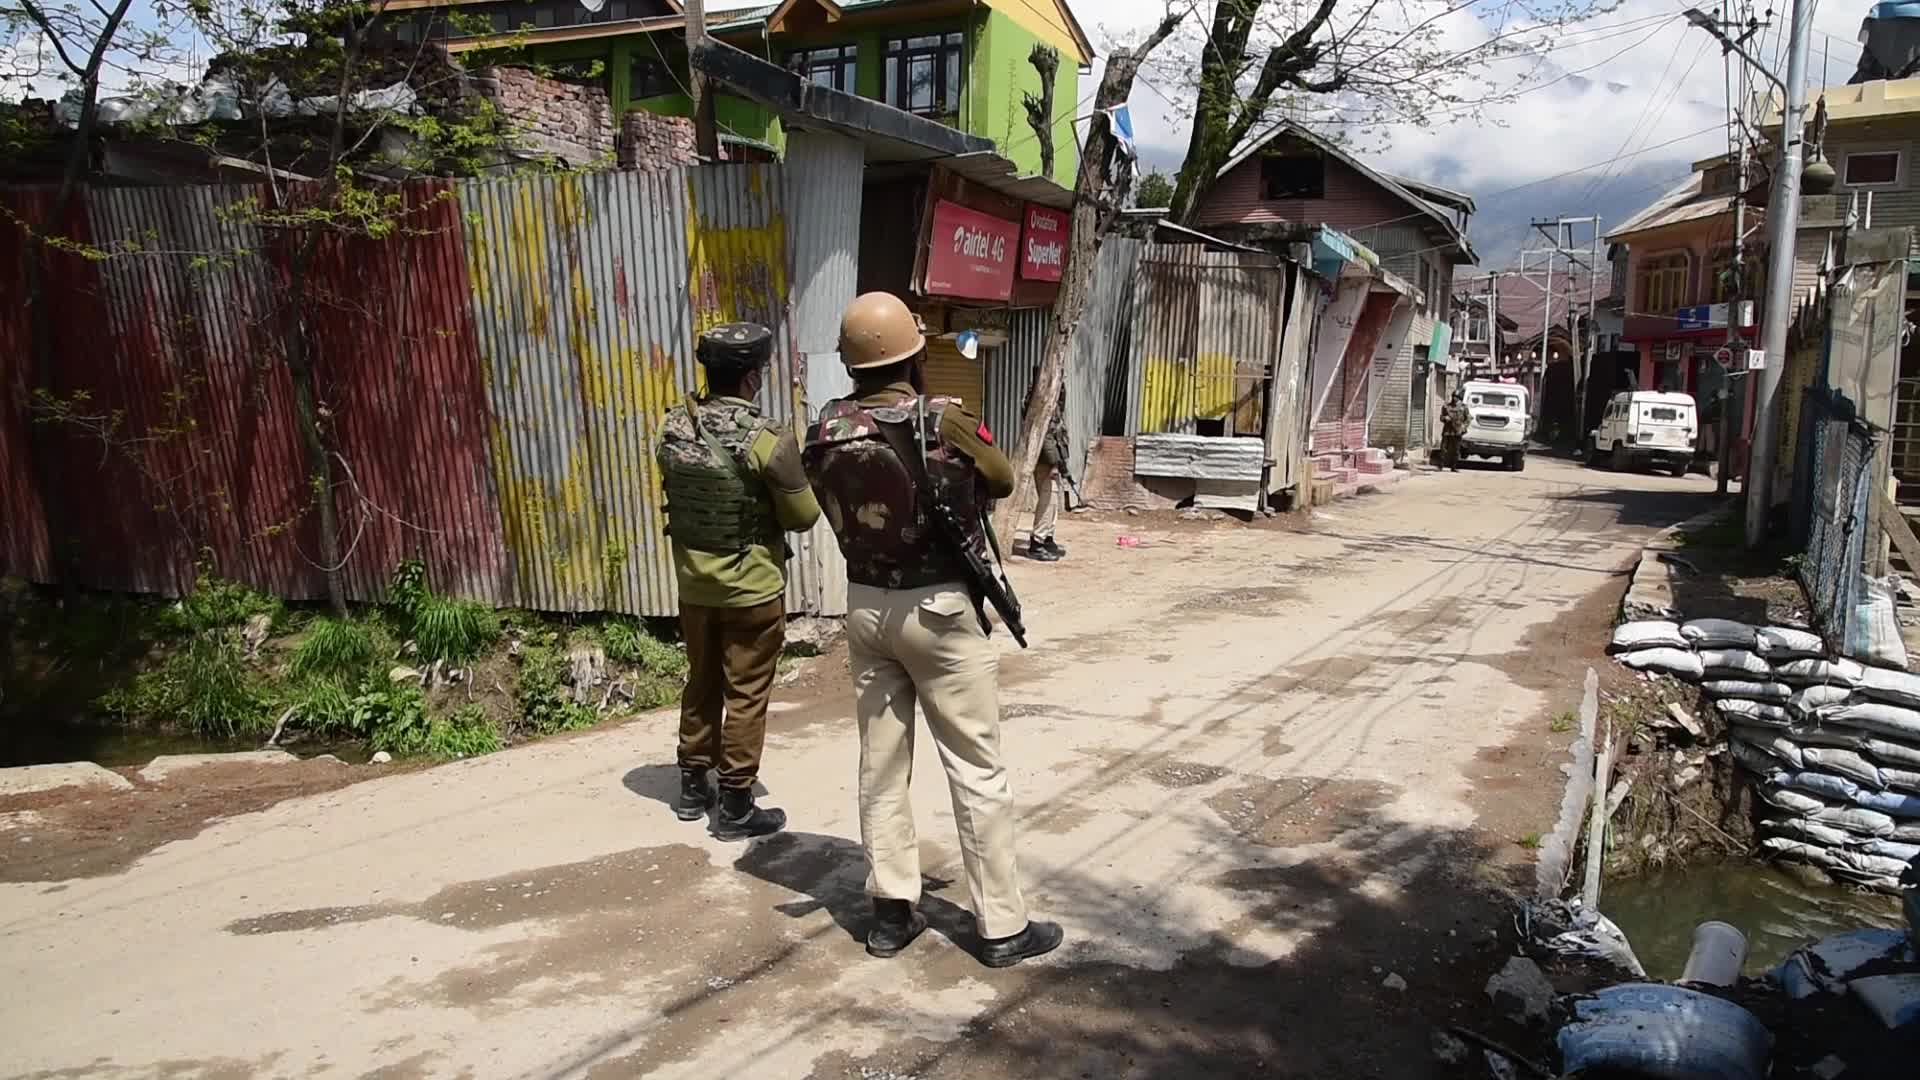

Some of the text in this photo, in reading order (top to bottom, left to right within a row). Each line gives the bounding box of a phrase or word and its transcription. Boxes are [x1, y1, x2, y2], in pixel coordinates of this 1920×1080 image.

[963, 226, 1005, 262] airtel 4G
[1028, 237, 1062, 270] SuperNet
